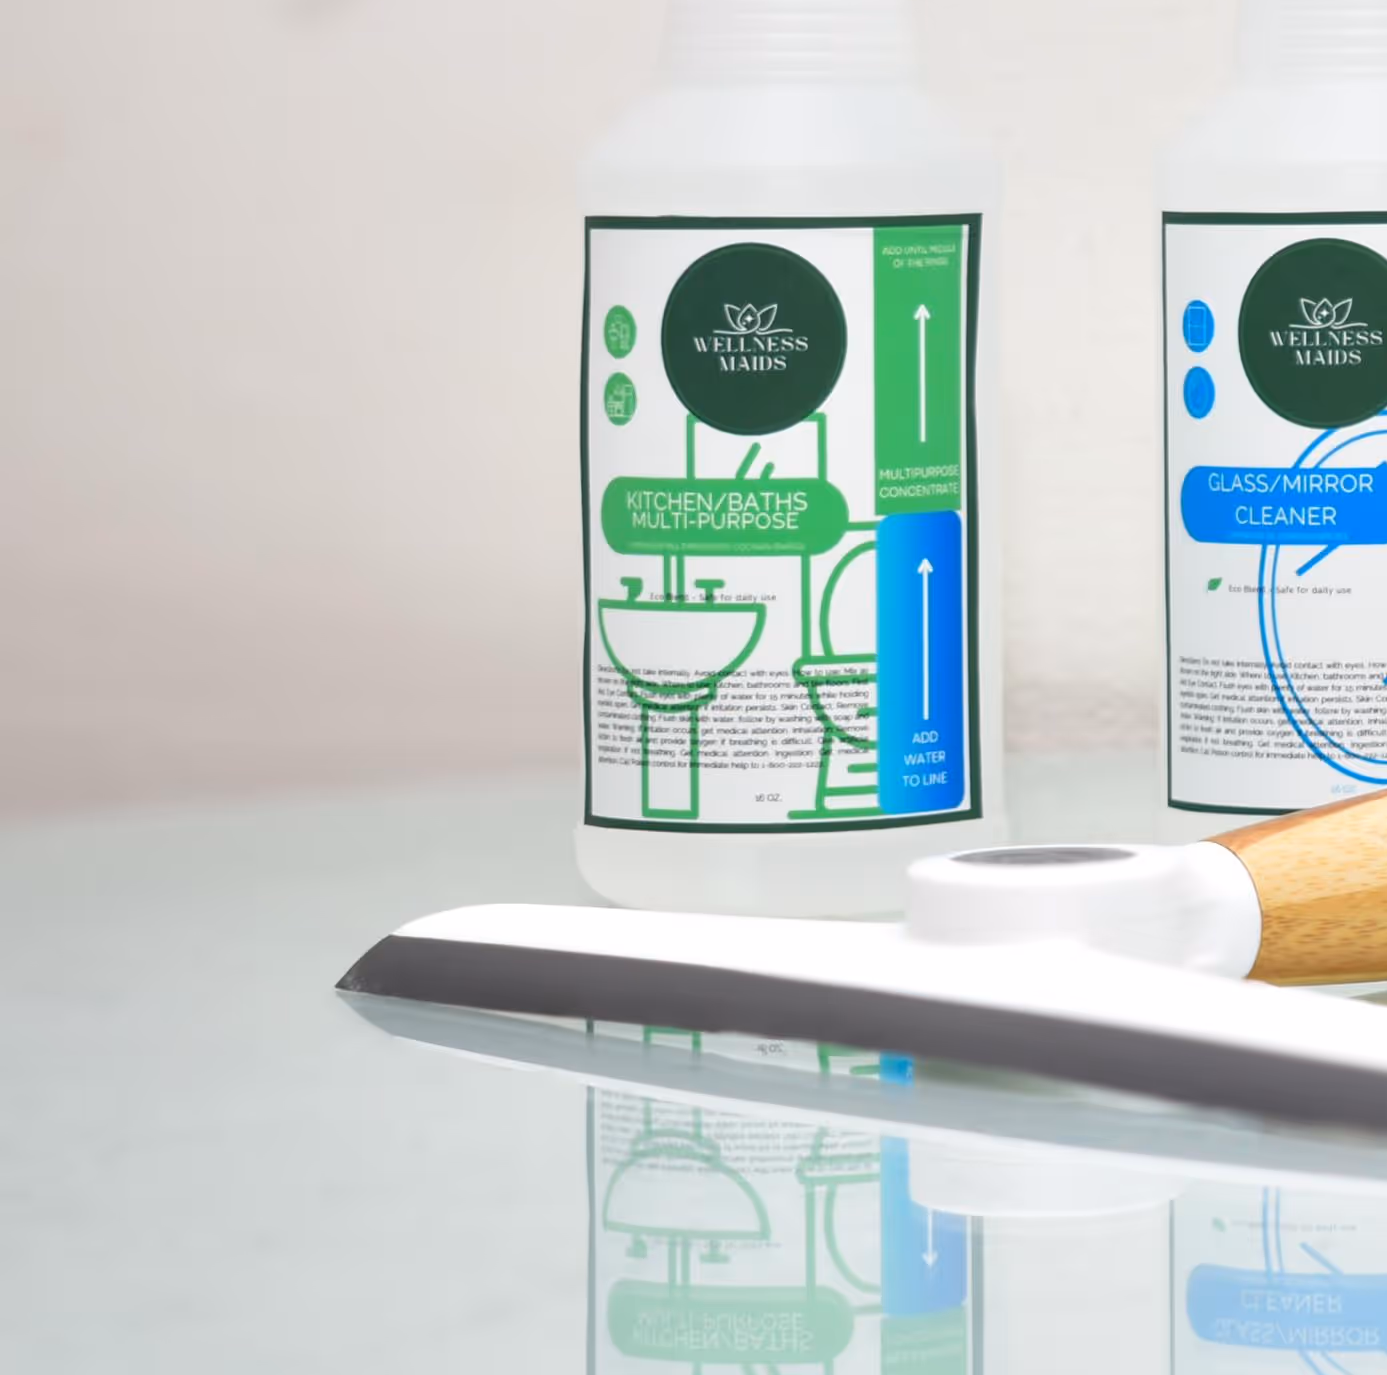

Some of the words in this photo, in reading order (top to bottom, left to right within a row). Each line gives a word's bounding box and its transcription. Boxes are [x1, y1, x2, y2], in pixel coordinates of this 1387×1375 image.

[693, 335, 809, 354] WELLNESS
[1269, 330, 1383, 348] WELLNESS
[719, 354, 788, 372] MAIDS
[1295, 348, 1362, 366] MAIDS
[879, 465, 960, 481] MULTIPURPOSE
[879, 482, 959, 498] CONCENTRATE
[1208, 472, 1374, 493] GLASS/MIRROR
[626, 491, 808, 512] KITCHEN/BATHS
[632, 511, 799, 530] MULTI-PURPOSE
[1235, 506, 1337, 525] CLEANER
[650, 592, 664, 601] Eco
[720, 592, 733, 602] for
[736, 593, 757, 604] daily
[761, 594, 777, 602] use
[1228, 584, 1242, 594] Eco
[1296, 585, 1309, 594] for
[1312, 585, 1334, 596] daily
[912, 730, 939, 745] ADD
[904, 748, 946, 767] WATER
[902, 773, 919, 787] TO
[921, 770, 947, 786] LINE
